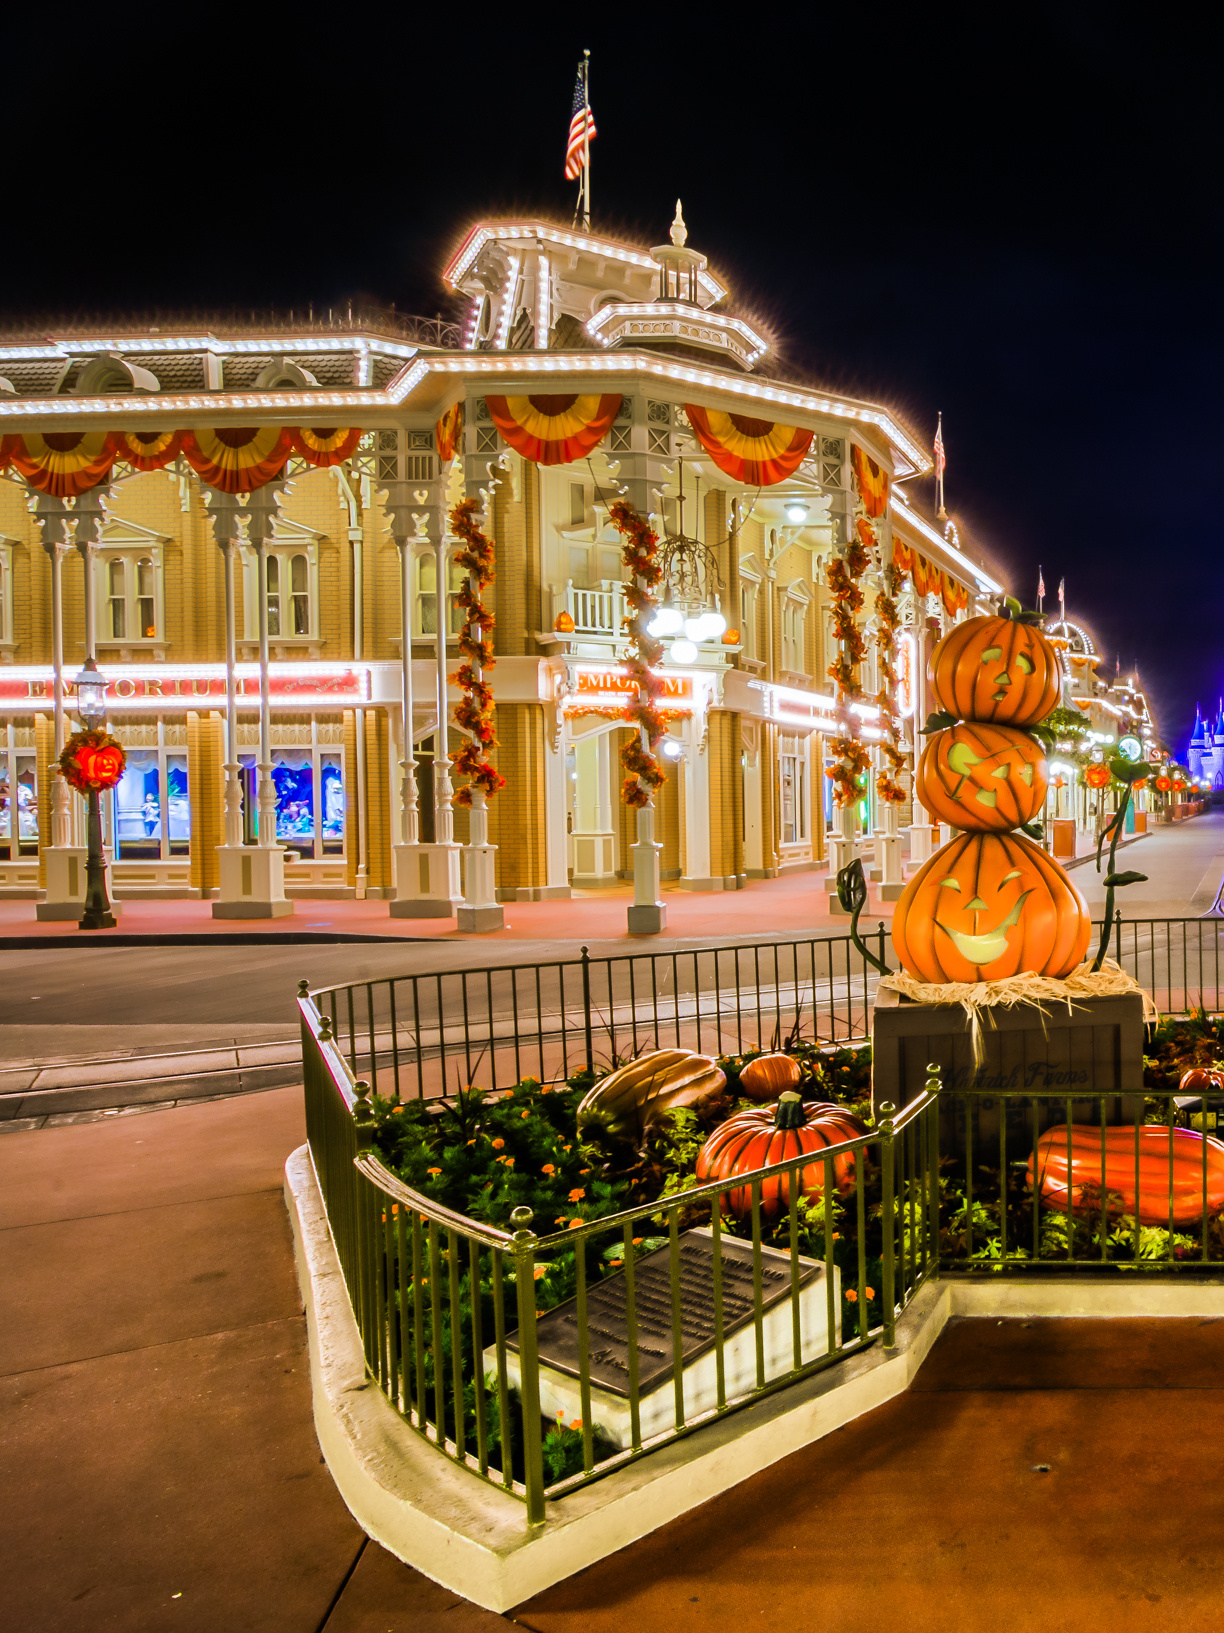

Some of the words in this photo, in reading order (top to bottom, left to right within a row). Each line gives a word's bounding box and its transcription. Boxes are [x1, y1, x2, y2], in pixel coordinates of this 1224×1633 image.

[24, 678, 248, 699] EMORIUM
[298, 678, 321, 686] Goods
[575, 673, 684, 695] EMPORM
